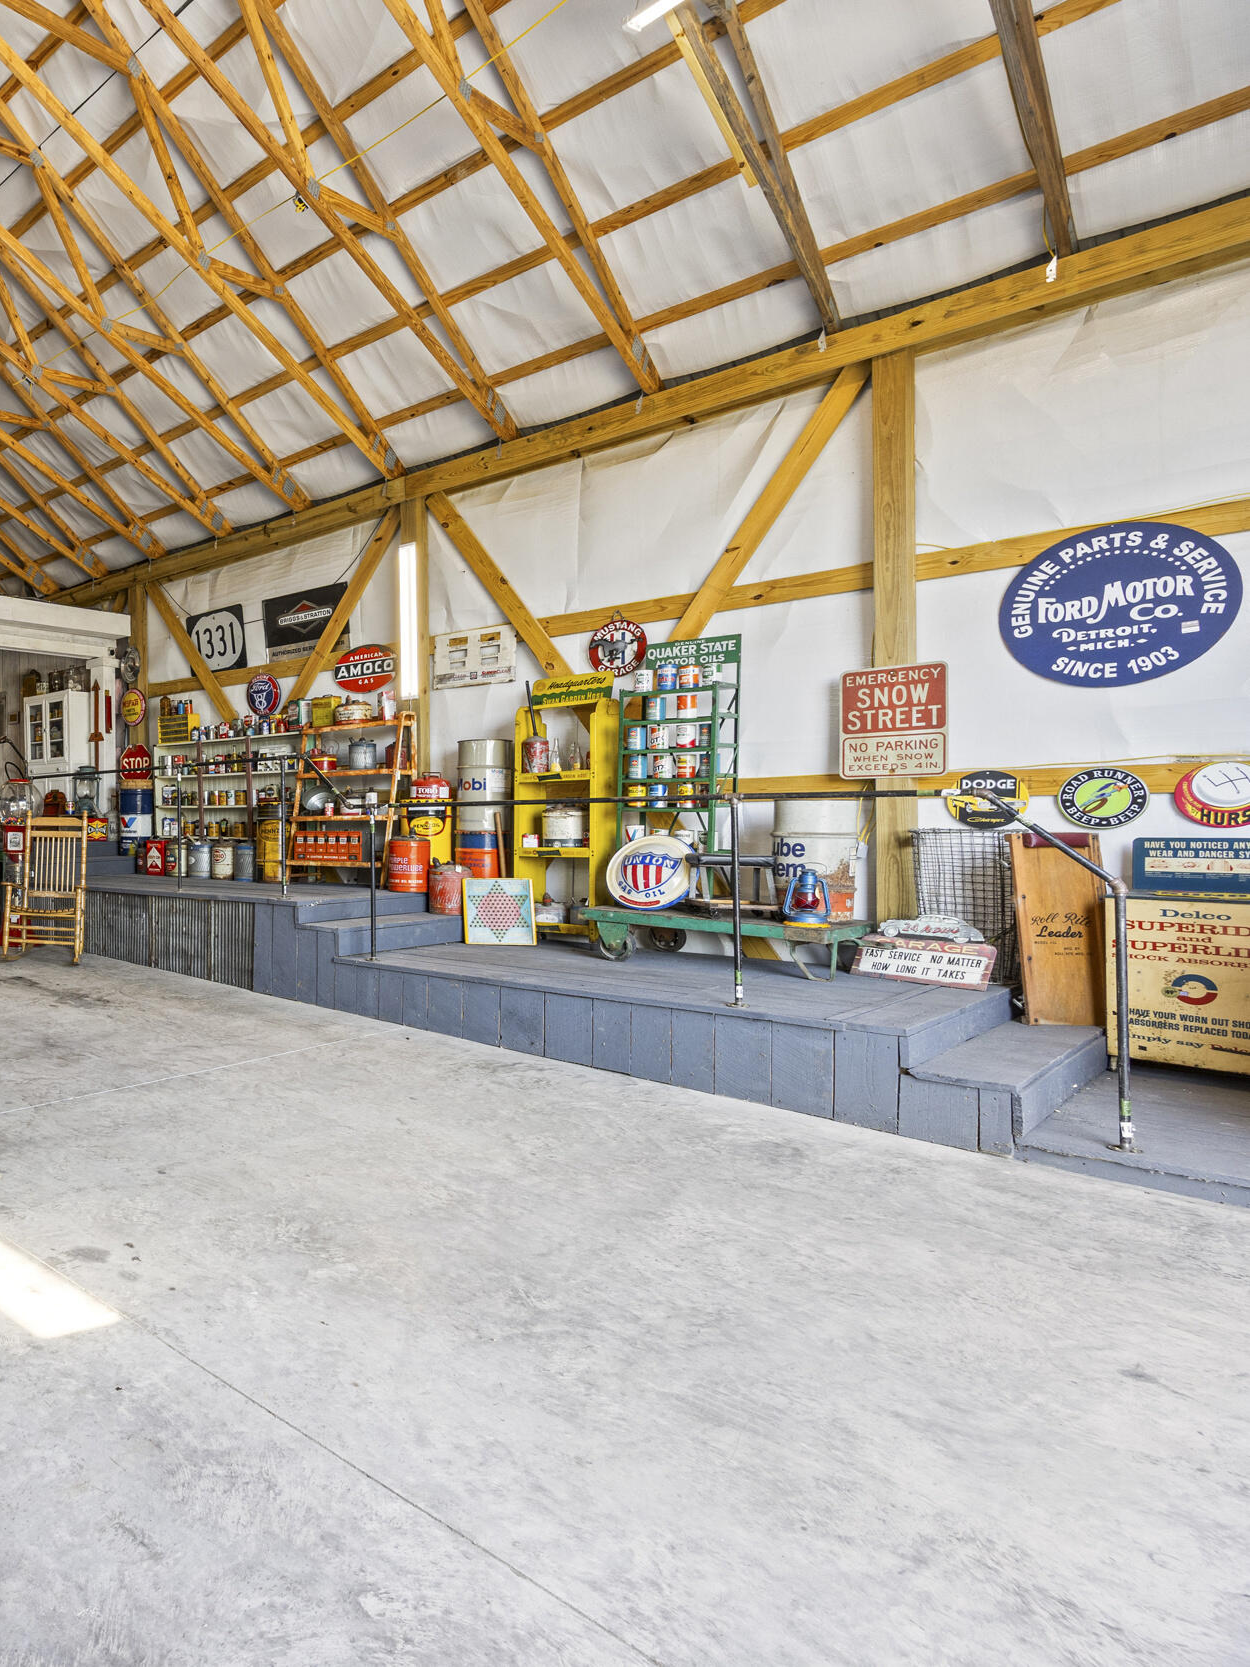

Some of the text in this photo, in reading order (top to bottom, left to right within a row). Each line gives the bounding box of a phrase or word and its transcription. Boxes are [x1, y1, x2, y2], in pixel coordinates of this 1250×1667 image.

[1011, 531, 1228, 639] GENUINE PARTS & SERVICE
[1038, 575, 1194, 624] FORD MOTOR
[280, 614, 300, 624] BRIGGS
[304, 609, 332, 620] STRATTON
[1129, 603, 1183, 621] CO.
[594, 620, 642, 642] MUSTANG
[1052, 623, 1157, 643] DETROIT,
[195, 621, 236, 660] 1331
[1079, 640, 1134, 652] MICH.
[272, 648, 302, 657] AUTHORIZED
[350, 651, 383, 661] AMERICAN
[648, 640, 736, 660] QUAKER STATE
[337, 660, 394, 678] AMOCO
[598, 660, 639, 677] GARAGE
[656, 654, 725, 669] MOTOR OILS
[1051, 645, 1180, 678] SINCE 1903
[547, 676, 606, 692] Headquarters
[846, 667, 941, 687] EMERGENCY
[250, 682, 270, 692] Ford
[856, 682, 930, 708] SNOW
[542, 692, 604, 705] SWAN GARDEN HOSE
[847, 704, 942, 731] STREET
[849, 738, 938, 753] NO PARKING
[896, 752, 934, 760] SNOW
[122, 756, 150, 774] STOP
[848, 762, 908, 772] EXCEEDS
[962, 779, 1015, 789] DODGE
[1063, 770, 1145, 800] ROAD RUNNER
[1067, 804, 1141, 826] BEEP BEEP
[625, 855, 676, 868] UNION
[1199, 850, 1234, 858] DANGER
[618, 881, 665, 898] GAS OIL
[1030, 912, 1092, 927] Roll Rite
[1159, 909, 1232, 921] Delco
[1036, 925, 1083, 938] Leader
[1176, 935, 1214, 944] and
[865, 949, 982, 968] FAST SERVICE NO MATTER
[871, 962, 891, 971] HOW
[896, 965, 917, 974] LONG
[937, 969, 966, 980] TAKES
[1129, 1008, 1150, 1018] HAVE
[1153, 1011, 1176, 1021] YOUR
[1179, 1014, 1208, 1024] WORN
[1211, 1018, 1230, 1027] OUT
[1128, 1019, 1180, 1031] ABSORBERS
[1184, 1025, 1228, 1037] REPLACED
[1176, 1041, 1204, 1049] say
